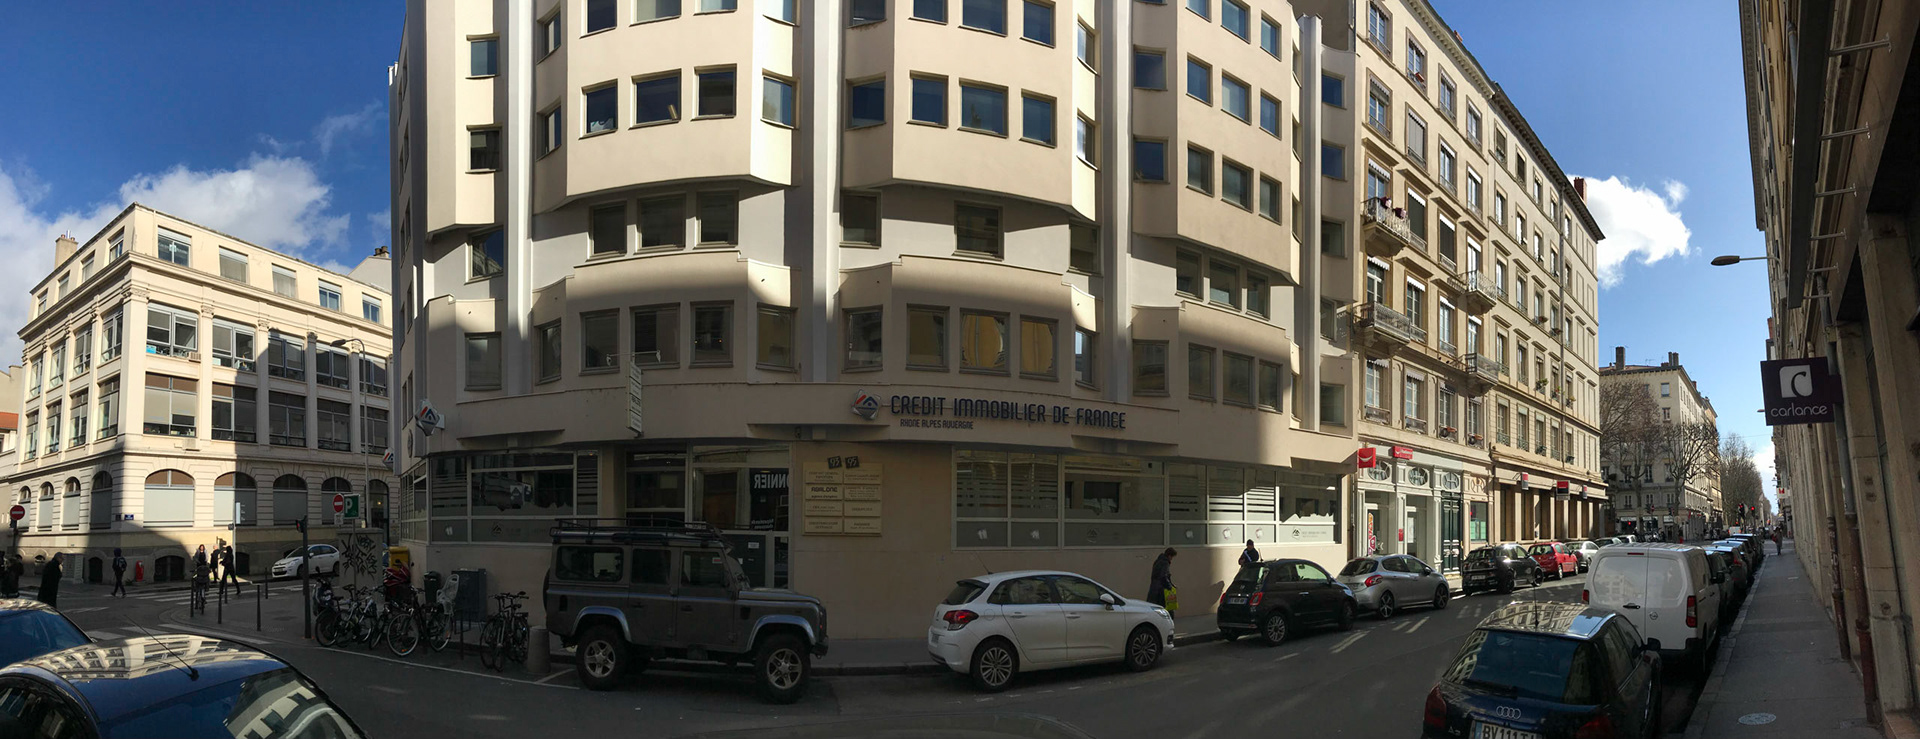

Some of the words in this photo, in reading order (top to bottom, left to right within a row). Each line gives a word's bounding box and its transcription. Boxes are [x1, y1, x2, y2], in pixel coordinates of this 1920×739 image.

[891, 395, 946, 416] CREDIT
[954, 398, 1046, 423] IMMOBILIER
[1053, 406, 1070, 424] DE
[1076, 408, 1126, 429] FRANCE
[1770, 402, 1828, 417] carlance
[900, 418, 920, 428] RHONE
[921, 419, 941, 428] ALPES
[942, 420, 974, 430] AUVERGNE
[829, 457, 840, 467] 93
[847, 457, 857, 467] 95
[345, 497, 353, 514] P
